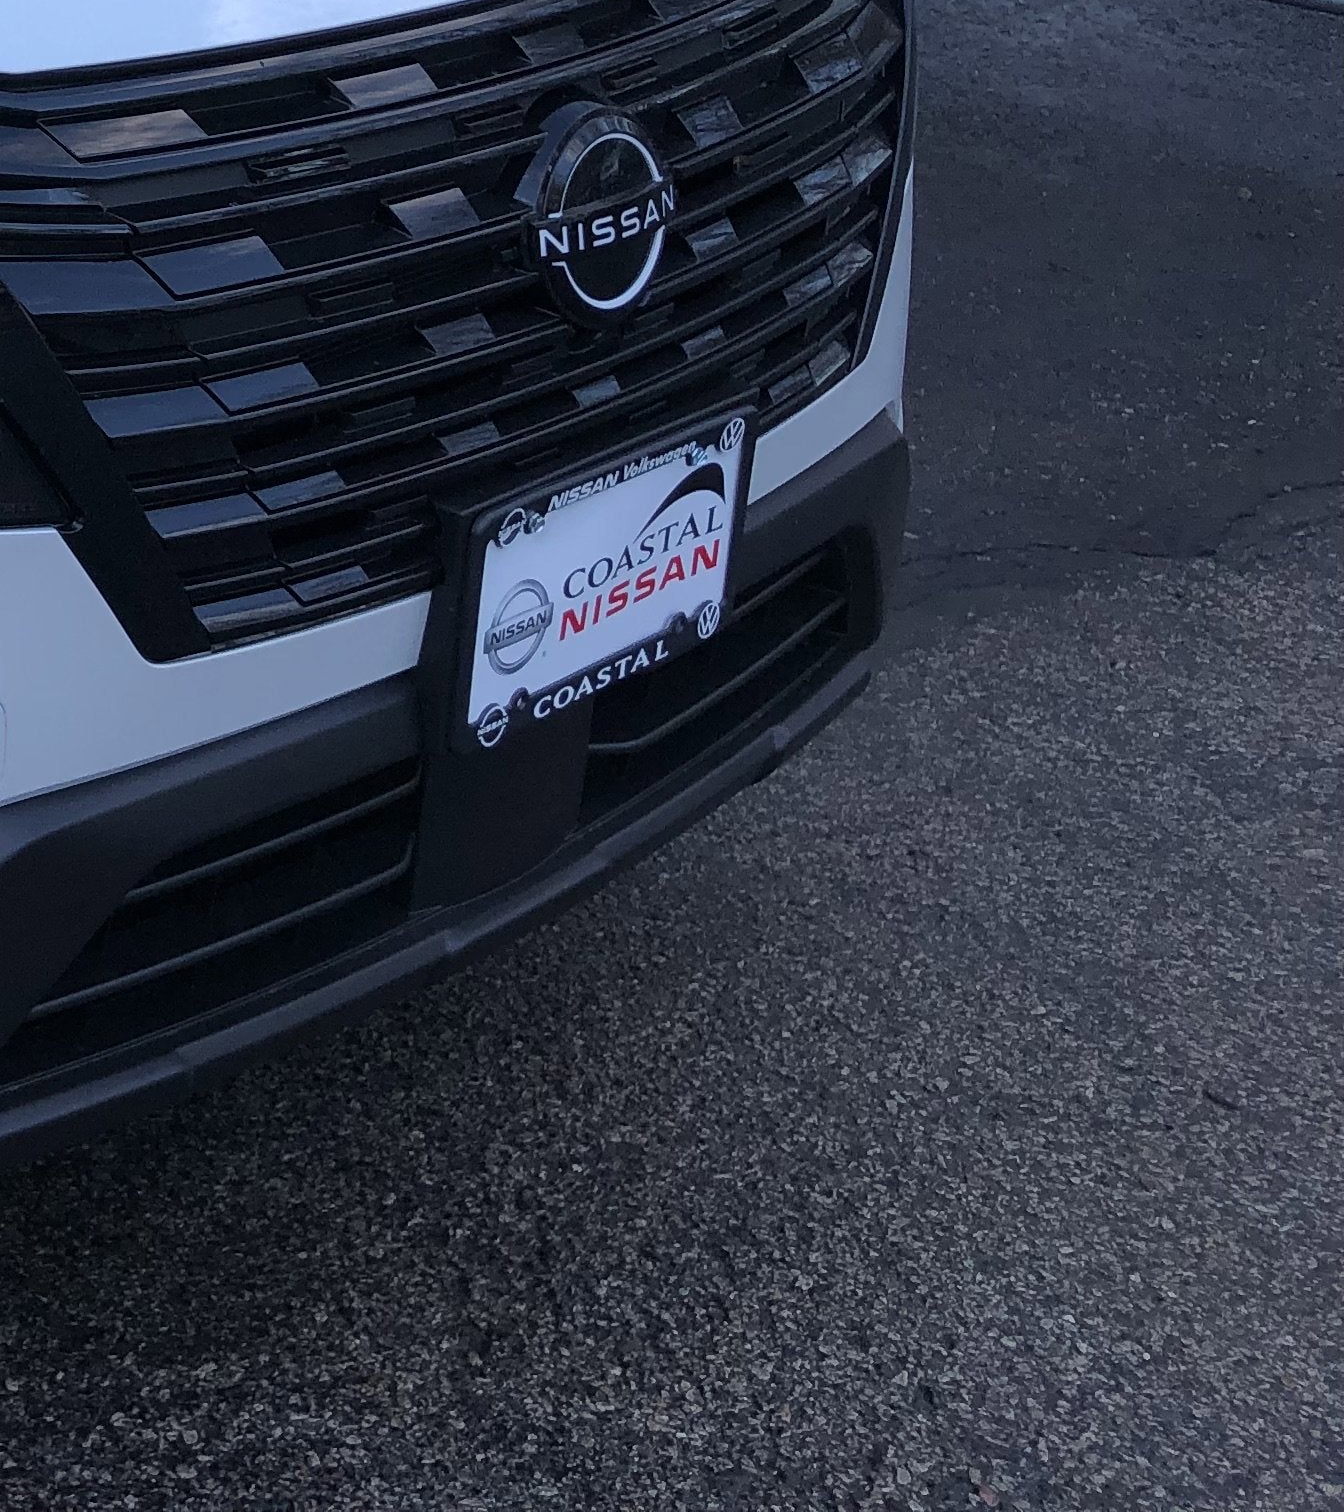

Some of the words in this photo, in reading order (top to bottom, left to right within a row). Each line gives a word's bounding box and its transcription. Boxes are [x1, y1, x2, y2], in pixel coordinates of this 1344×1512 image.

[538, 184, 675, 257] NISSAN
[547, 470, 620, 512] NISSAN
[623, 441, 696, 480] Volkswagen
[558, 539, 720, 641] NISSAN
[562, 505, 724, 599] COASTAL
[490, 610, 547, 645] NISSAN
[532, 640, 670, 719] COASTAL
